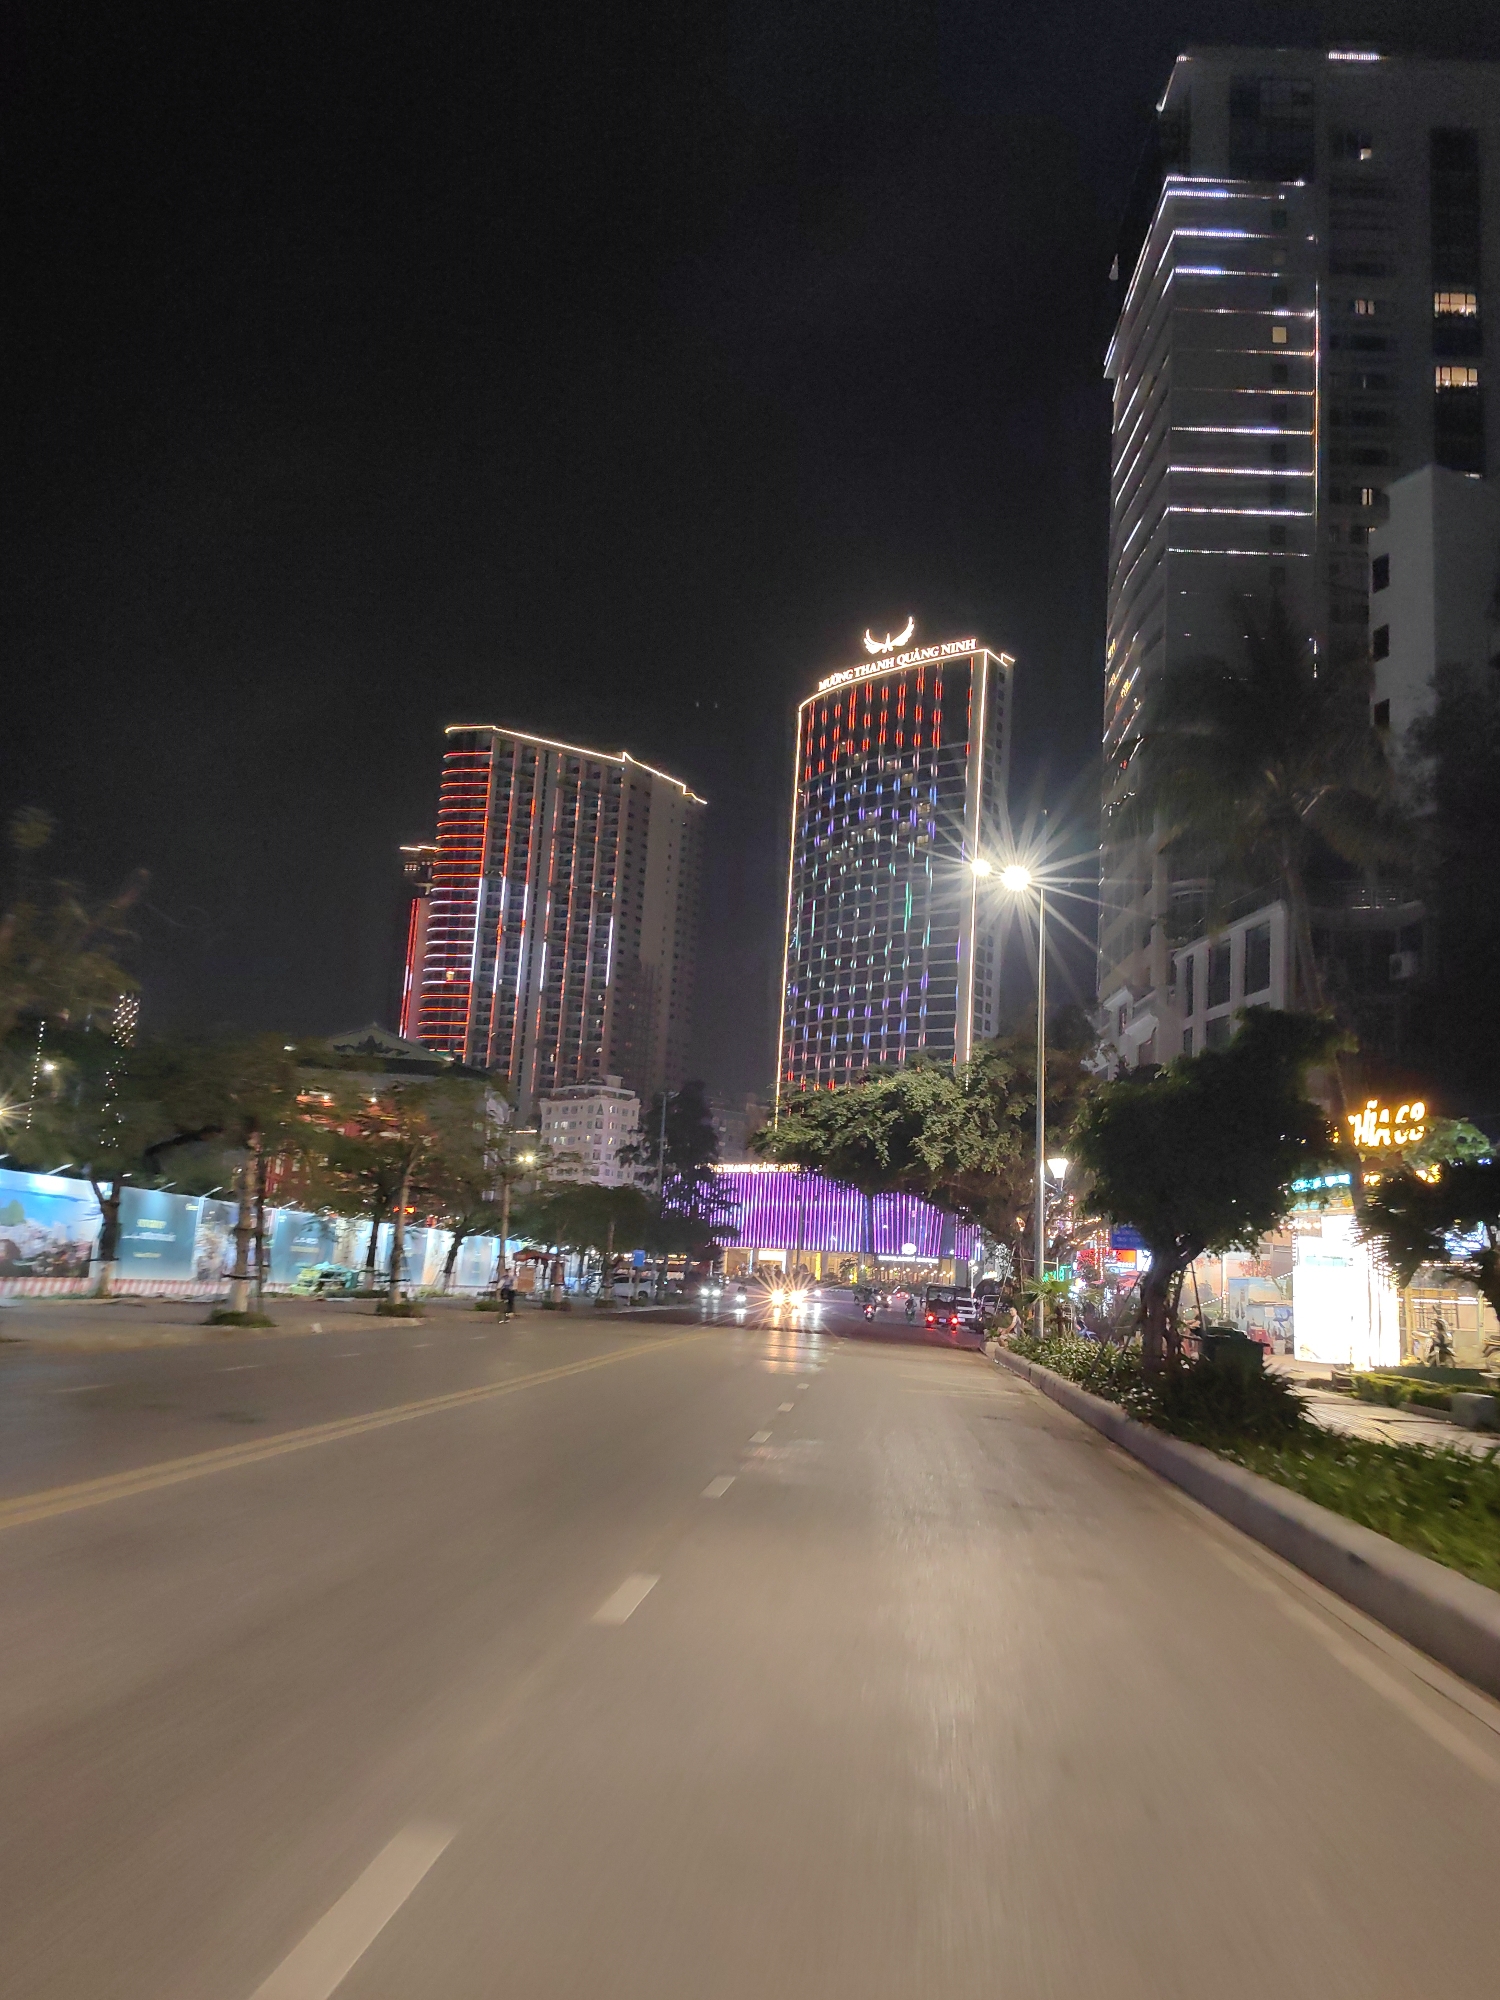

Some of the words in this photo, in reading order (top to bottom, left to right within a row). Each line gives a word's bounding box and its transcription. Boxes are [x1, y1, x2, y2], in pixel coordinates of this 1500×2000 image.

[817, 668, 854, 692] MƯỜNG
[854, 657, 895, 676] THANH
[896, 646, 940, 668] QUẢNG
[940, 638, 977, 656] NINH
